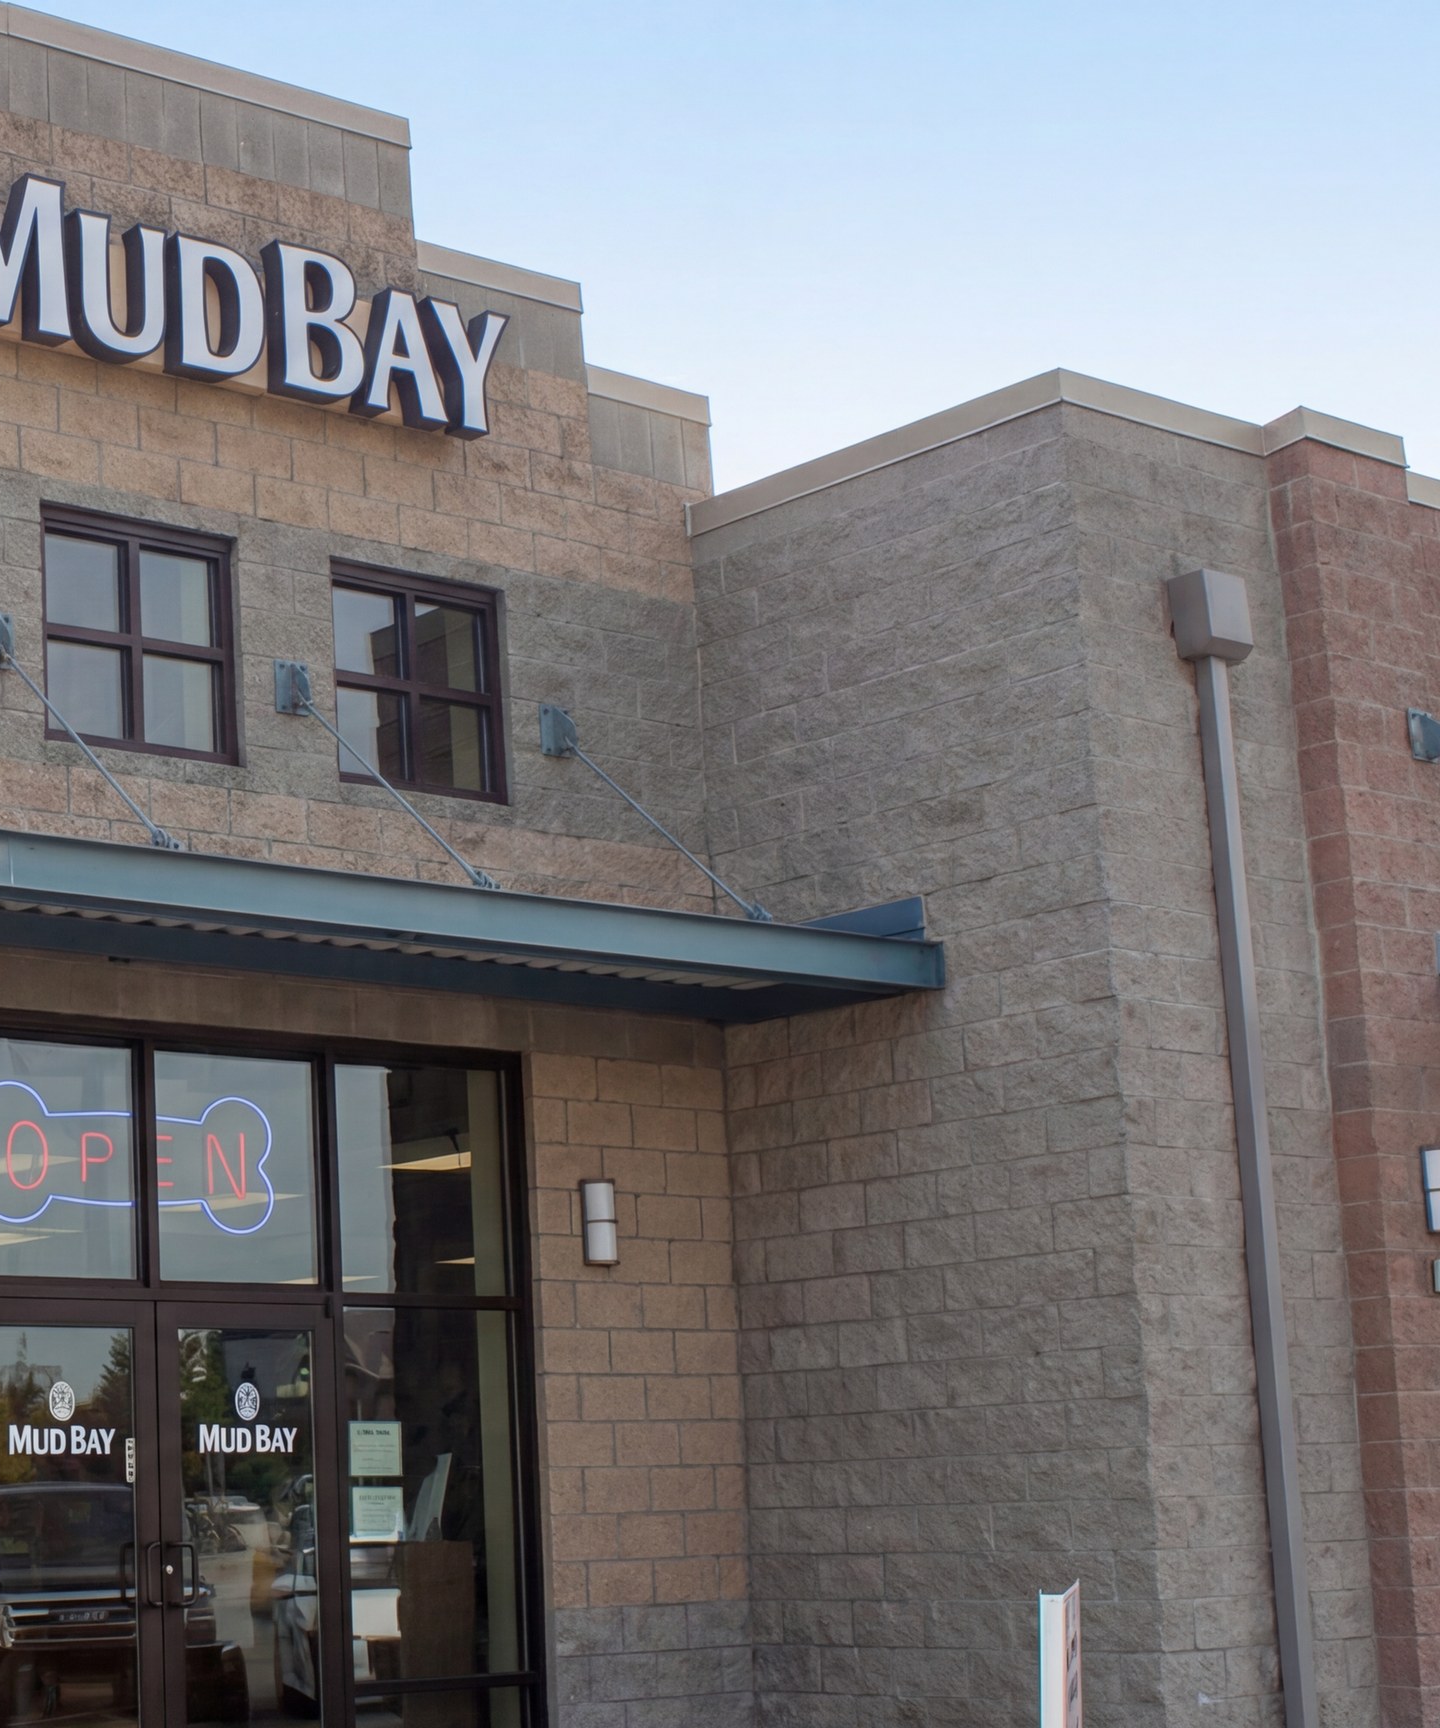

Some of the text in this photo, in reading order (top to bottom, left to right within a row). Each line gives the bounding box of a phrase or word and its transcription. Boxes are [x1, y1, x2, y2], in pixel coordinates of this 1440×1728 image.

[6, 1120, 247, 1200] OPEN
[8, 1424, 116, 1455] MUD BAY
[198, 1424, 298, 1453] MUD BAY
